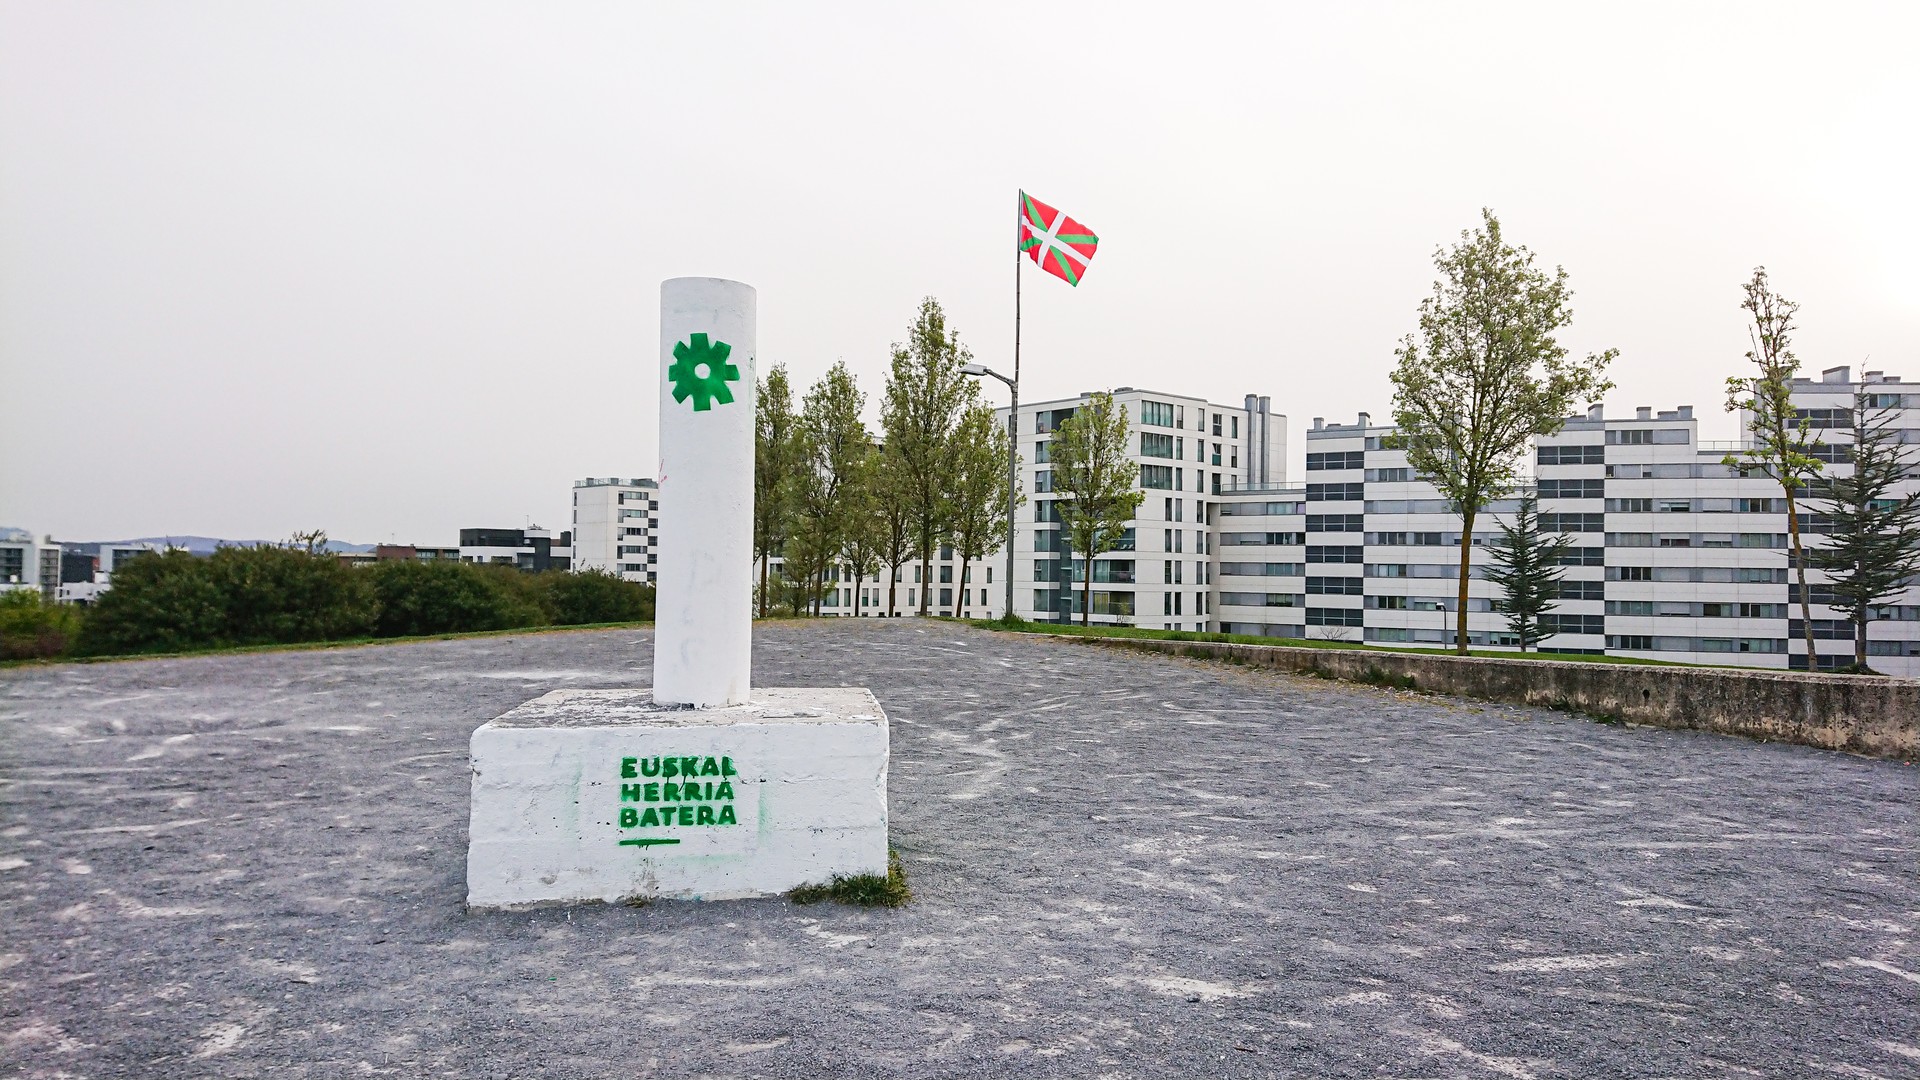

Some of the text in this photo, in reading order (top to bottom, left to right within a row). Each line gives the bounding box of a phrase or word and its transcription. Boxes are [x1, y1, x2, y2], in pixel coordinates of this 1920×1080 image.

[621, 756, 737, 779] EUSKAL
[621, 781, 734, 802] HERRIA
[620, 804, 737, 828] BATERA
